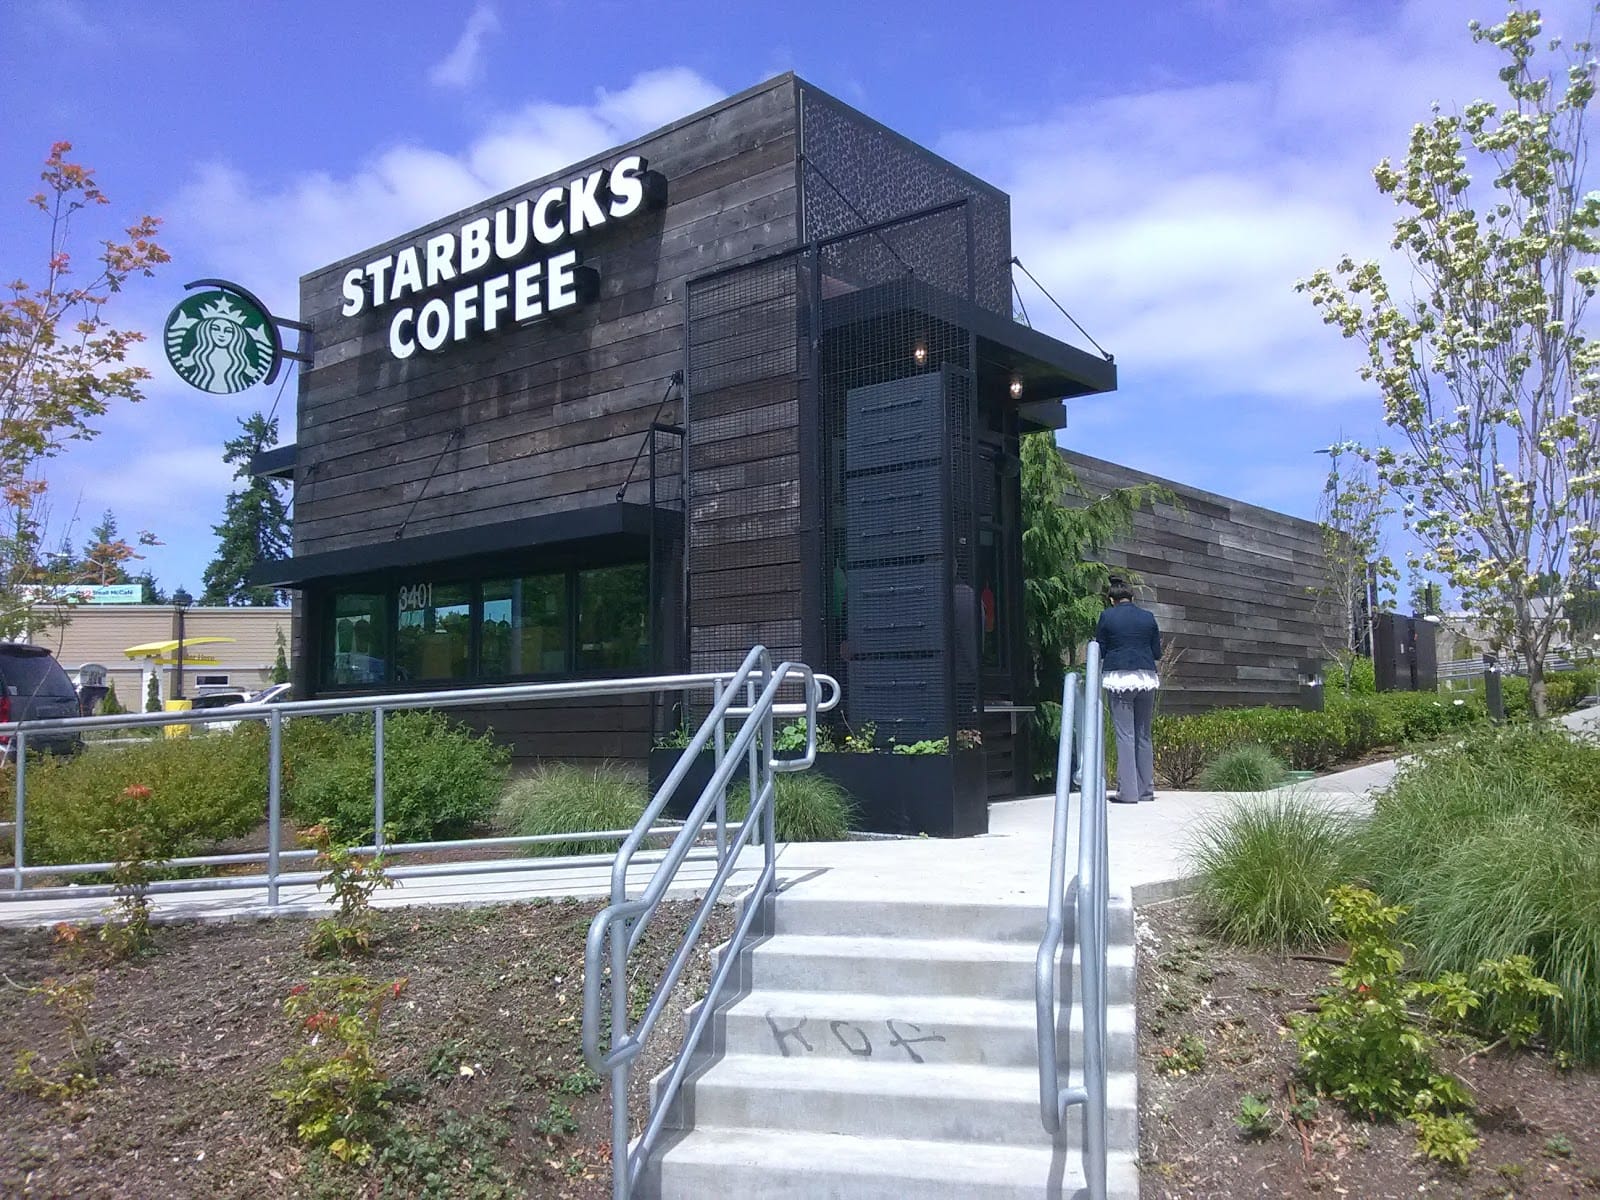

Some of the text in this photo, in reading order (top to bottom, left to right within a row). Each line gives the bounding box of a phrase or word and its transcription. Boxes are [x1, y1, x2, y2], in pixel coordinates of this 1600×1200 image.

[341, 156, 646, 318] STARBUCKS
[388, 250, 578, 360] COFFEE
[399, 582, 432, 609] 3401
